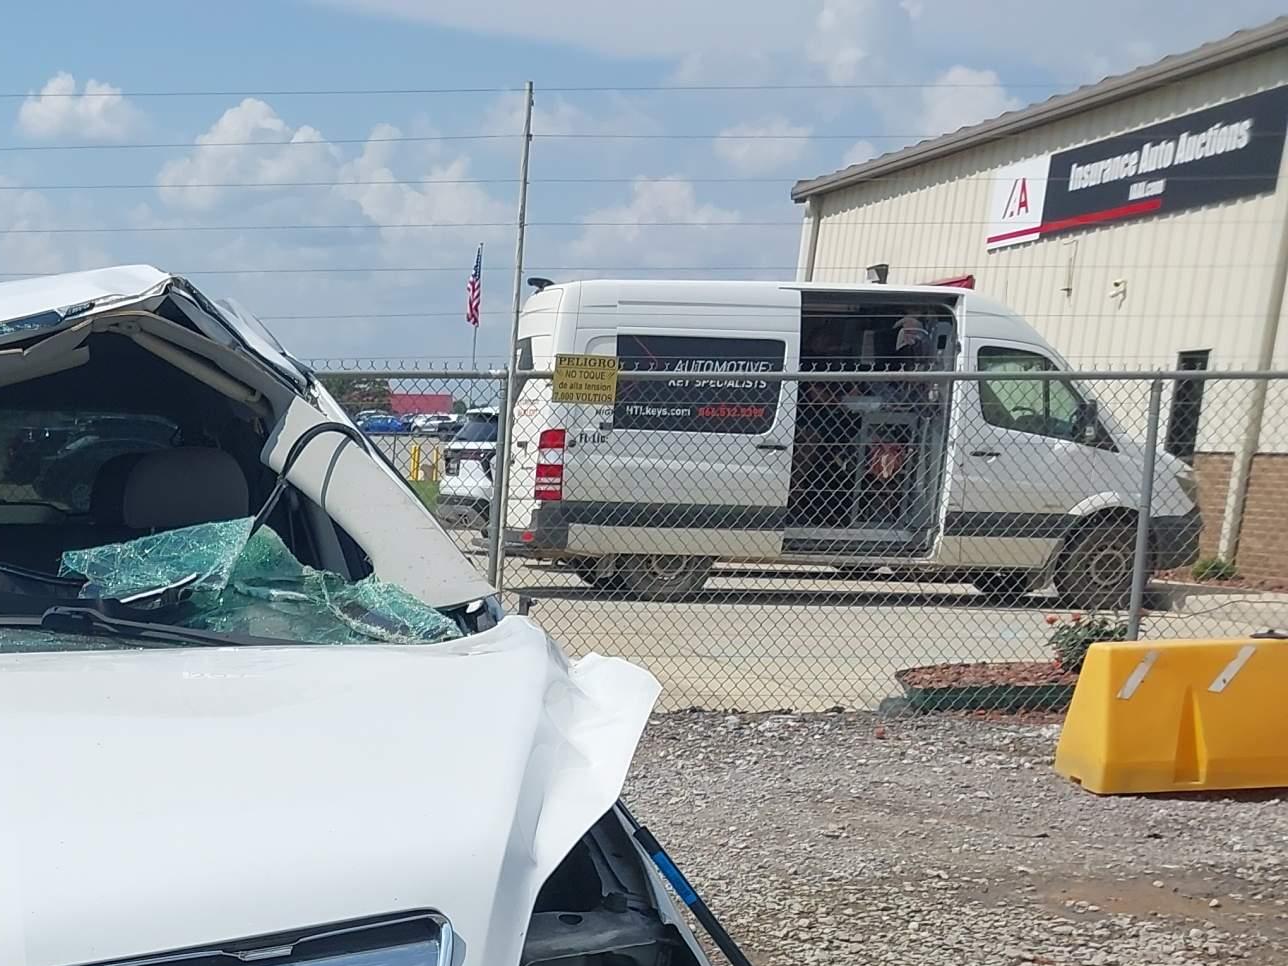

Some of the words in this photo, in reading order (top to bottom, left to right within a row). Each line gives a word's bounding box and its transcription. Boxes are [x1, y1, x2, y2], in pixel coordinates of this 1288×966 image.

[1068, 151, 1139, 191] Insurance
[1138, 140, 1175, 174] Auto
[1174, 118, 1253, 167] Auctions
[559, 357, 616, 368] PELIGRO
[674, 360, 769, 373] AUTOMOTIVE
[566, 370, 577, 378] NO
[579, 371, 606, 380] TOQUE
[575, 393, 613, 401] VOLTIOS
